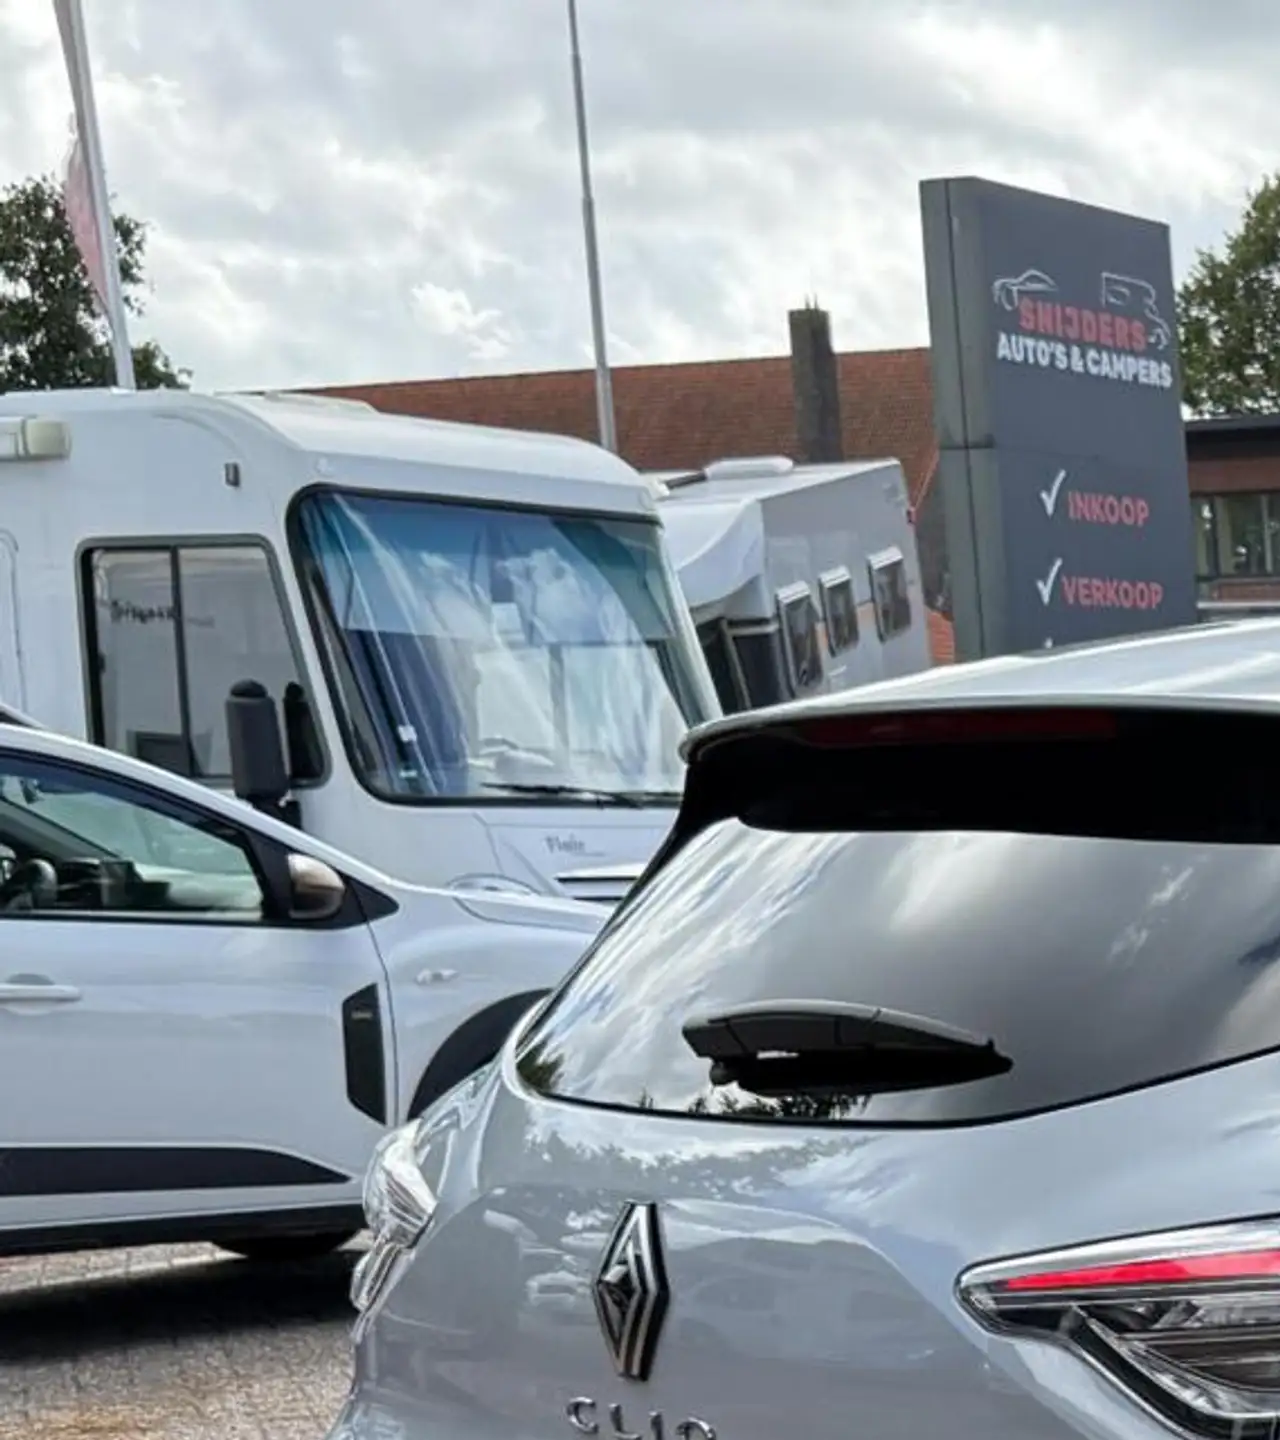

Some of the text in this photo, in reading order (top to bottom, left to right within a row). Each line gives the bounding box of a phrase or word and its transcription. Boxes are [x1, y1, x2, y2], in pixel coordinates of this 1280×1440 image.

[1019, 296, 1147, 351] SNIJDERS
[997, 331, 1173, 388] AUTO'S & CAMPERS
[1067, 490, 1150, 527] INKOOP
[1061, 575, 1164, 609] VERKOOP
